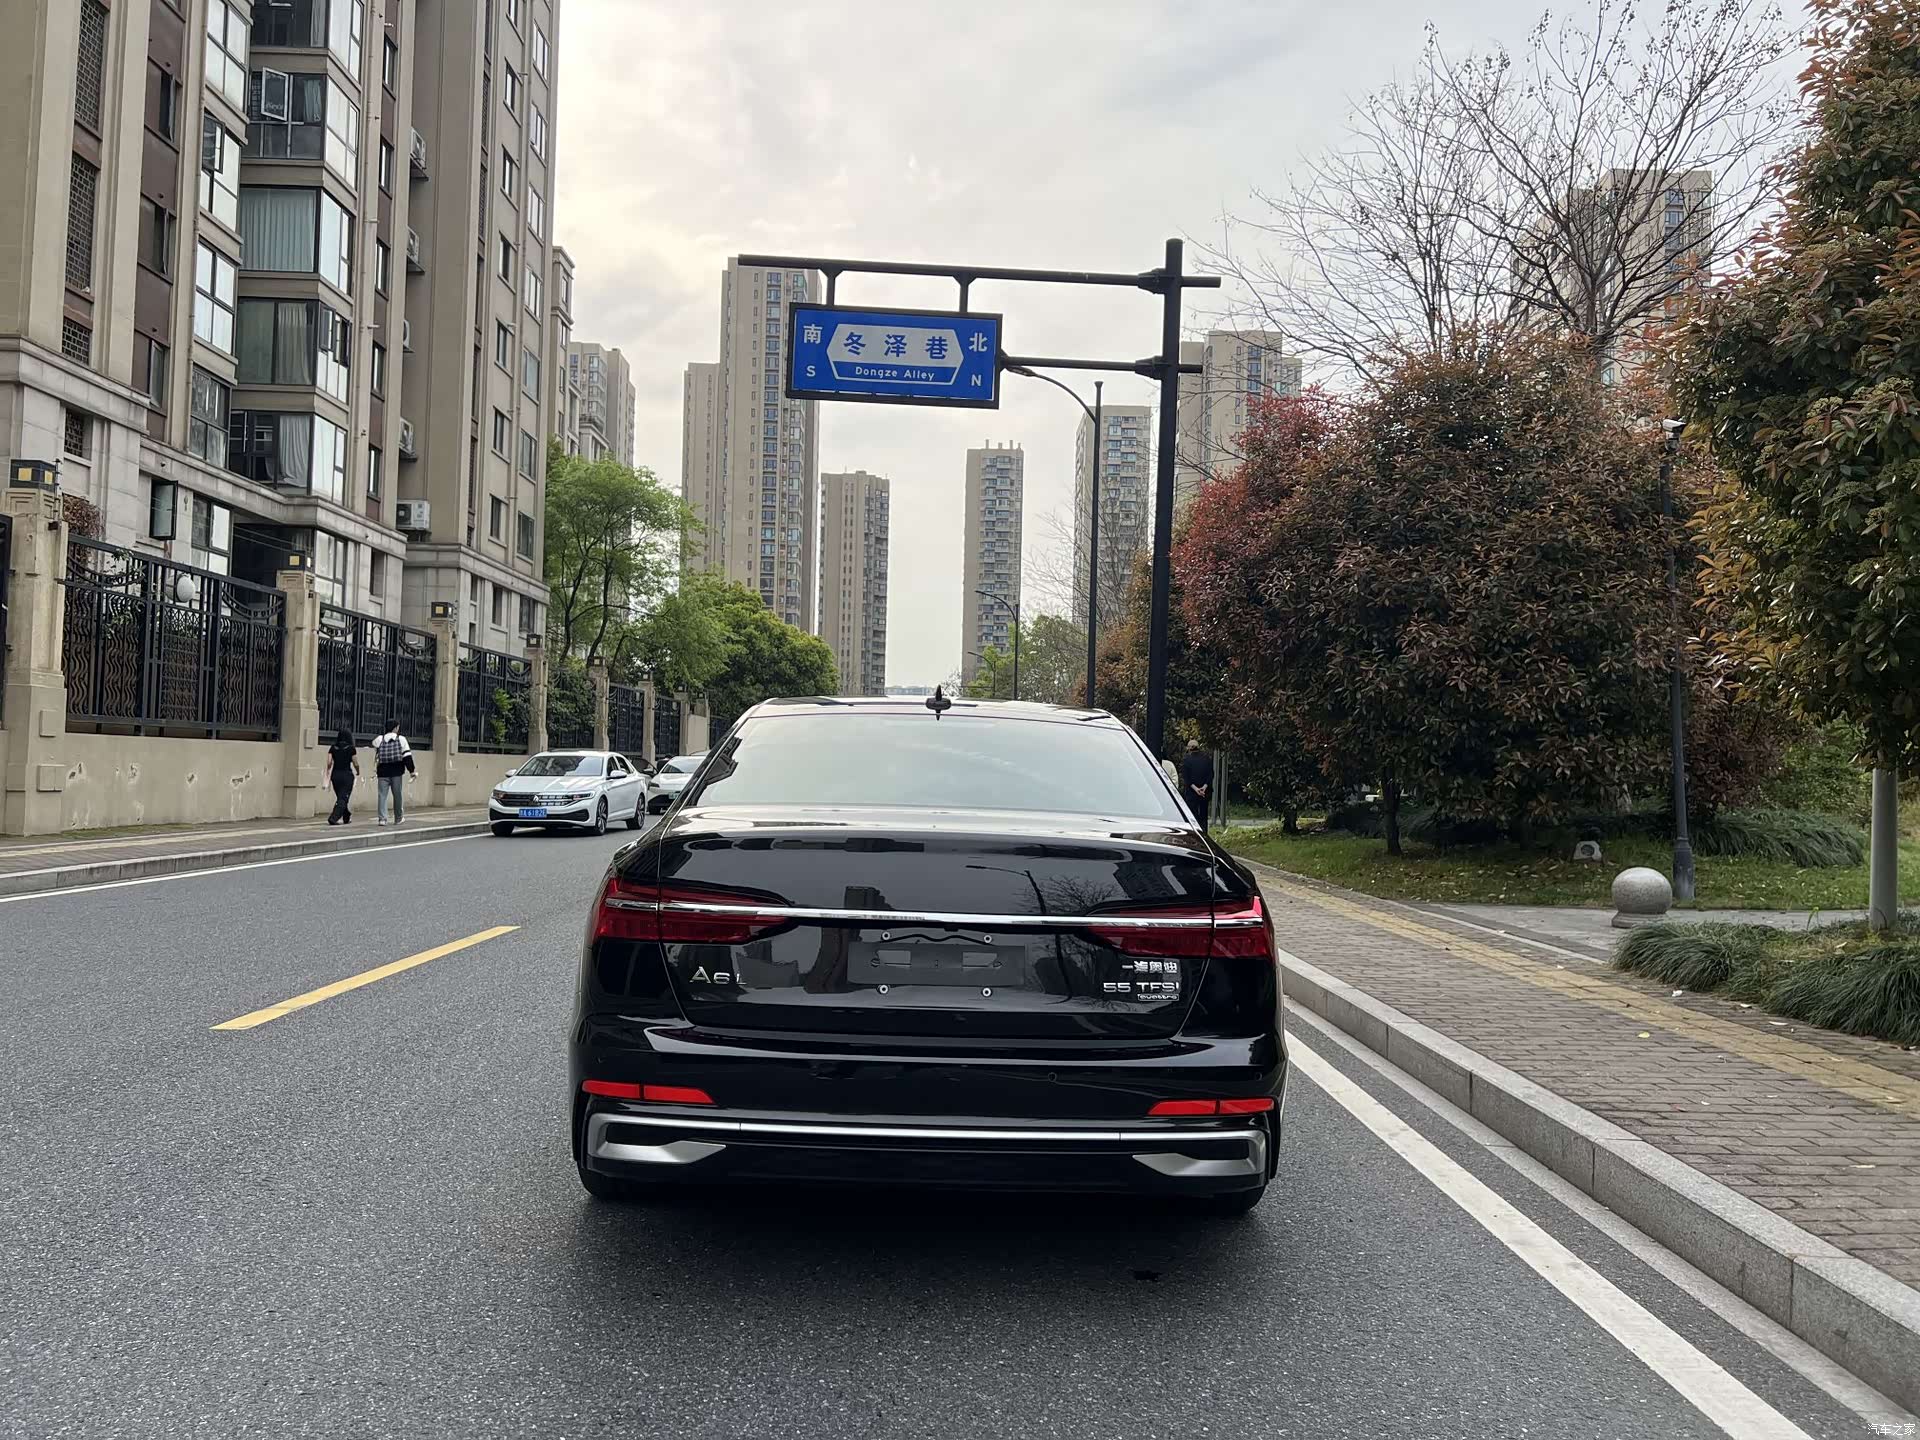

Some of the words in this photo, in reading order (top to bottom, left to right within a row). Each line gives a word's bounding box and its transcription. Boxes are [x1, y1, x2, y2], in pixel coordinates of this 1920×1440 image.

[803, 324, 823, 345] 南
[968, 332, 988, 353] 北
[843, 332, 949, 360] 冬泽巷
[806, 365, 816, 377] S
[855, 366, 898, 378] Dongze
[904, 369, 935, 381] Alley
[971, 374, 982, 386] N
[689, 966, 747, 985] A6L
[1103, 982, 1132, 993] 55
[1136, 981, 1180, 993] TFSI
